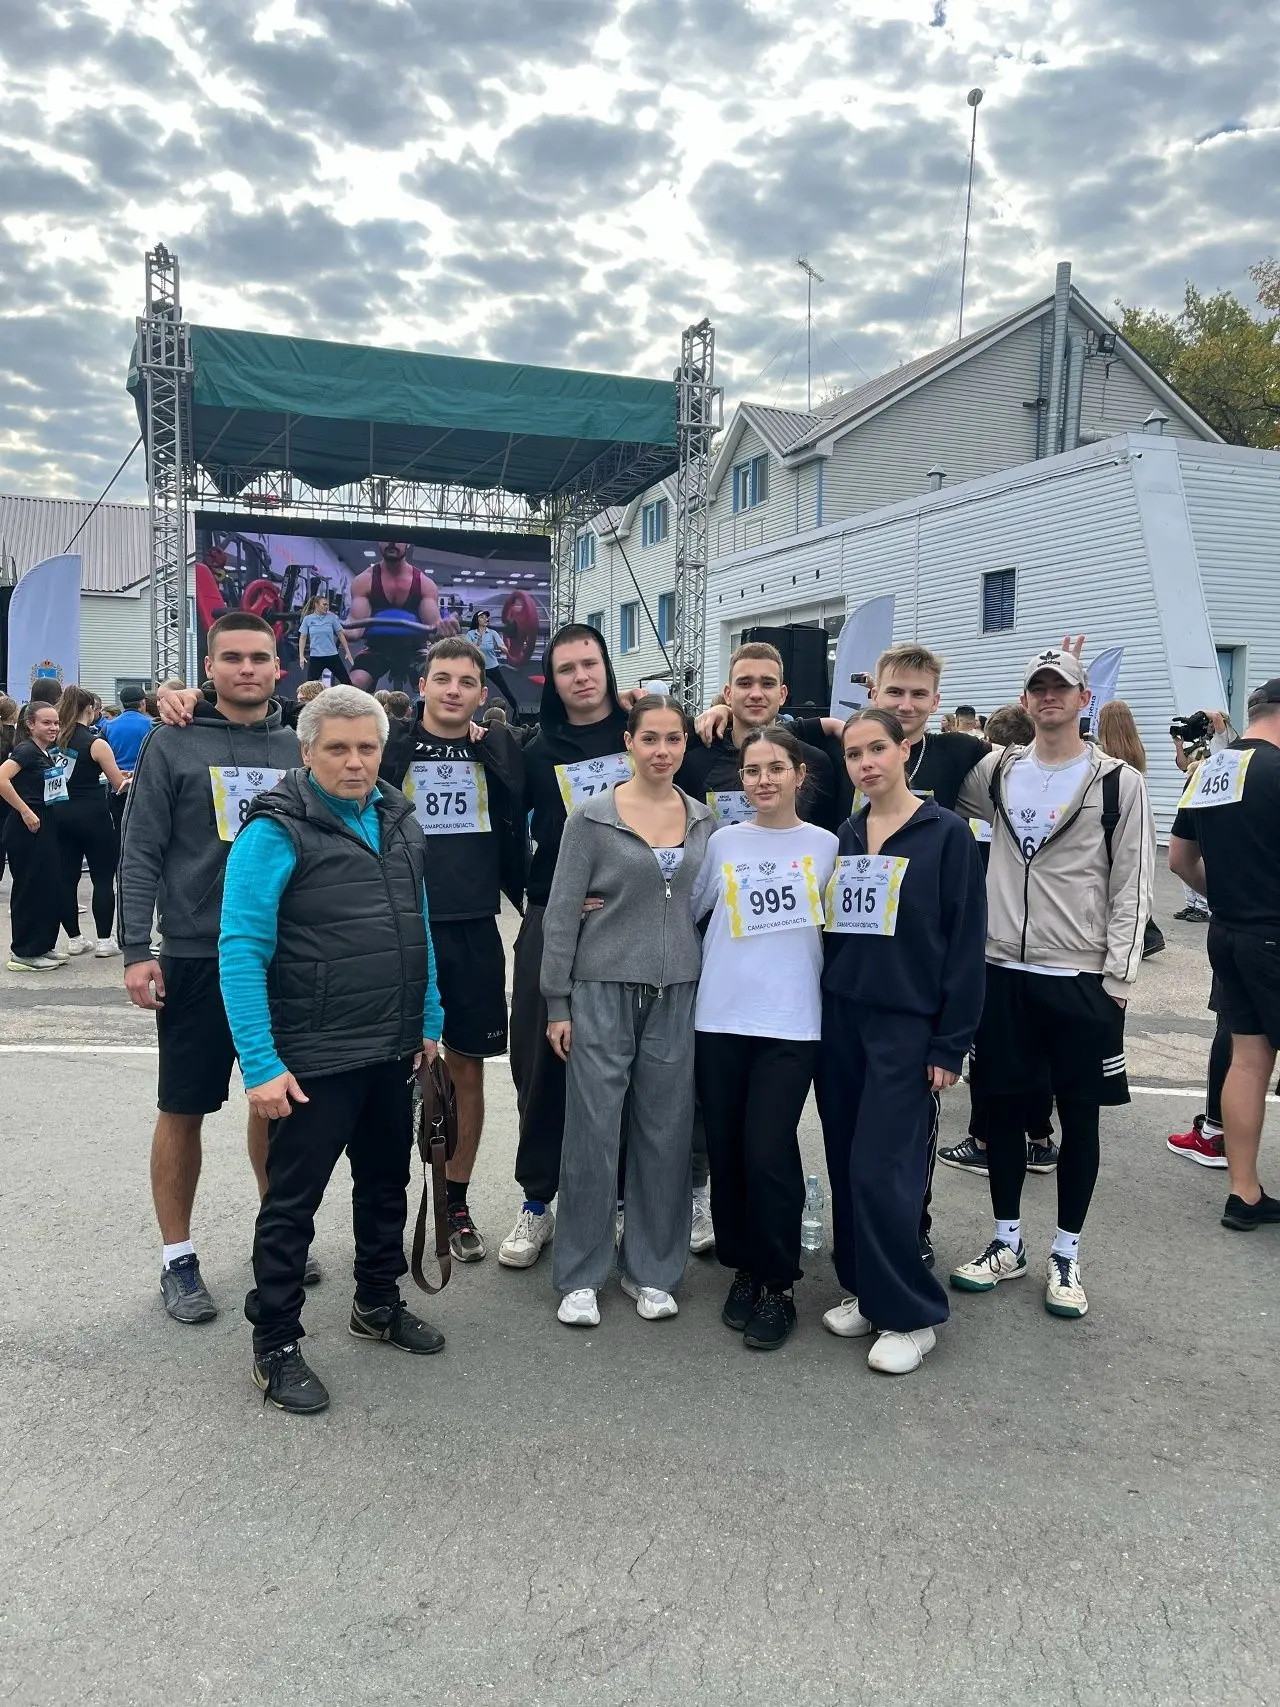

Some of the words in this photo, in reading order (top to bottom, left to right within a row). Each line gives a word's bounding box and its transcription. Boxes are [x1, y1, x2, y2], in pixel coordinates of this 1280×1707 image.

[1038, 660, 1061, 668] adidas
[1201, 772, 1230, 796] 456
[425, 792, 467, 816] 875
[750, 885, 796, 915] 995
[842, 887, 877, 913] 815
[747, 921, 781, 931] САМАРСКАЯ
[781, 917, 807, 926] ОБЛАСТЬ
[487, 1030, 504, 1039] ZARA
